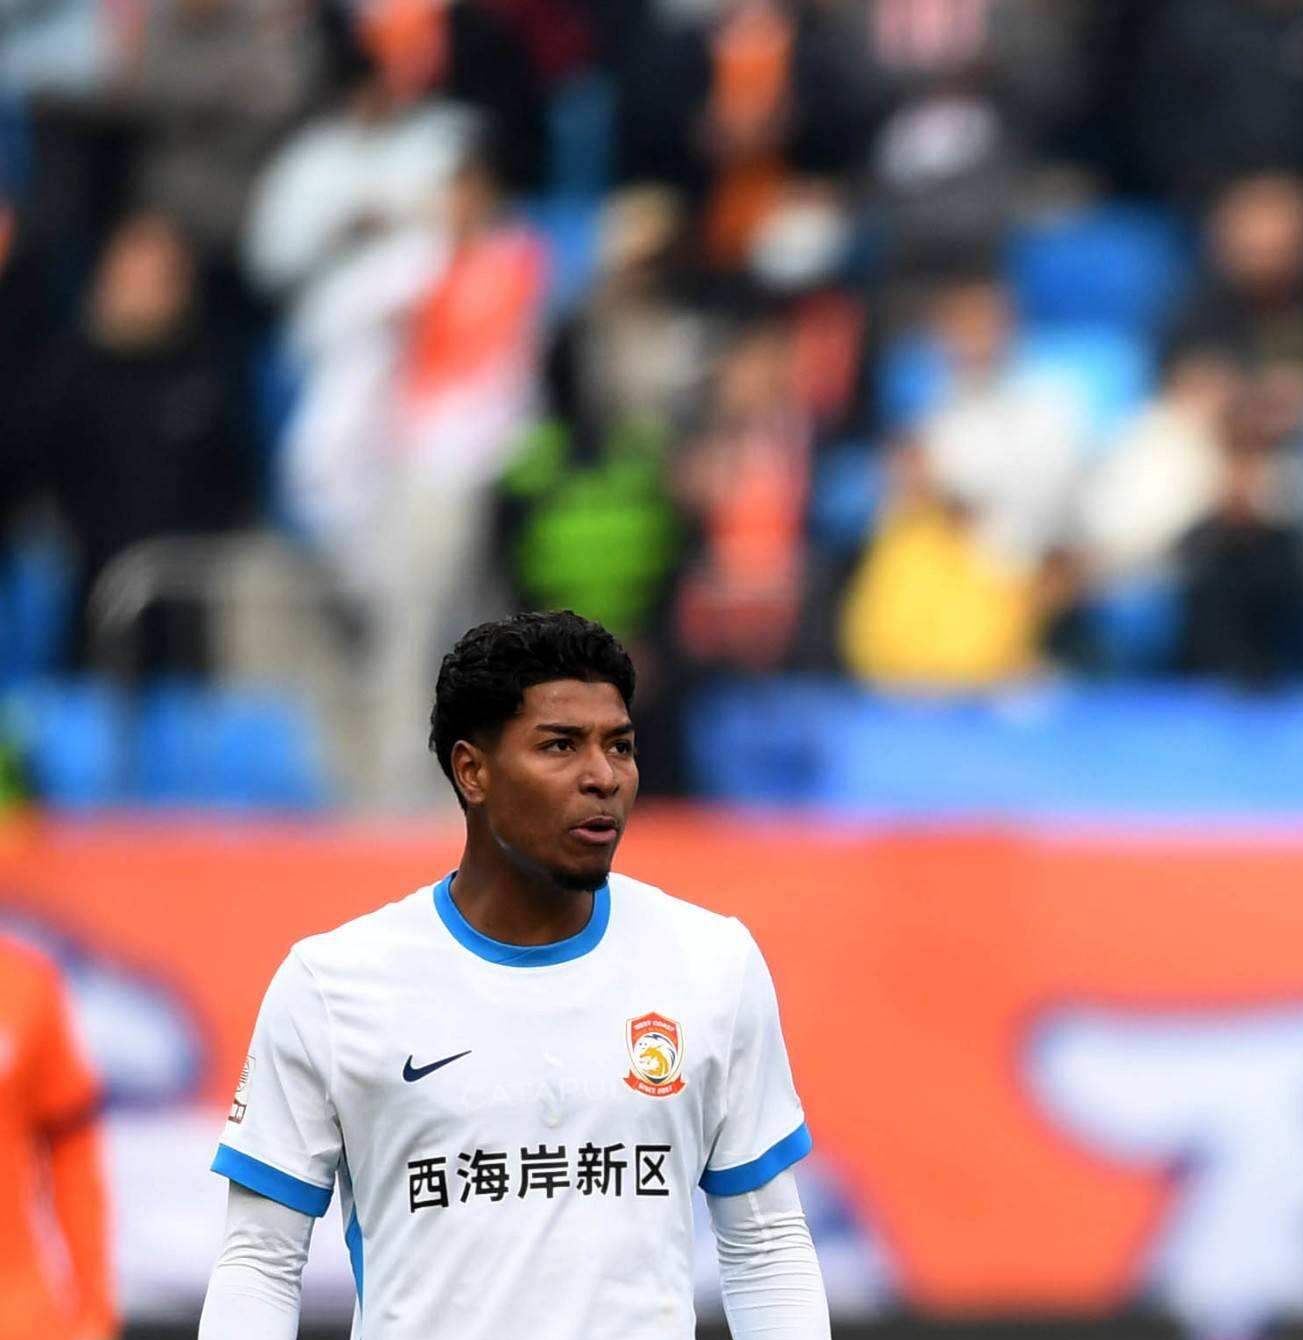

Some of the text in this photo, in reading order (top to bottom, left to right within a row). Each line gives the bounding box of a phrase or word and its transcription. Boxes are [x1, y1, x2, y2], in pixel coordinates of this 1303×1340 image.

[407, 1142, 672, 1213] 西海岸新区
